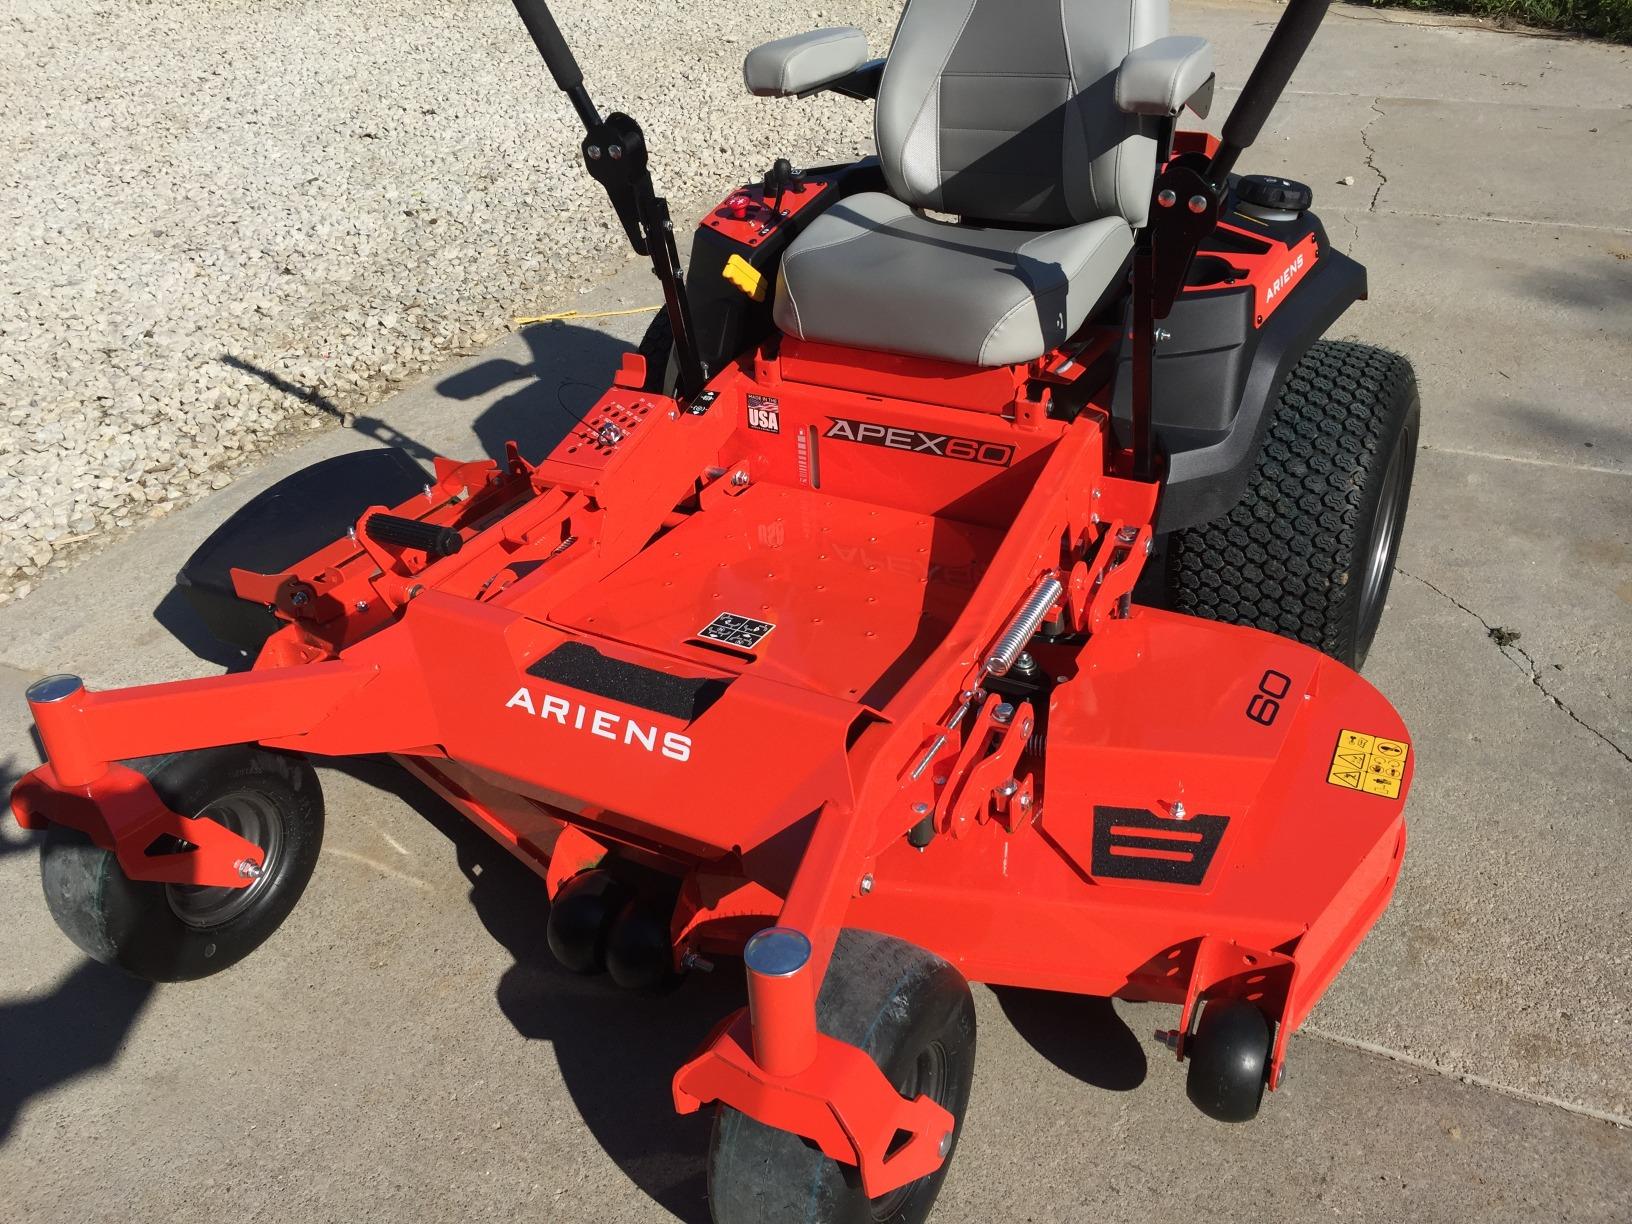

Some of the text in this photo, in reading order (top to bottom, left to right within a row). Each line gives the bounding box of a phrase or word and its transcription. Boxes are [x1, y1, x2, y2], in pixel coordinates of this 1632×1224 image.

[1265, 253, 1304, 304] ARIENS
[748, 408, 779, 430] USA
[505, 686, 692, 762] ARIENS
[1246, 669, 1291, 726] 60
